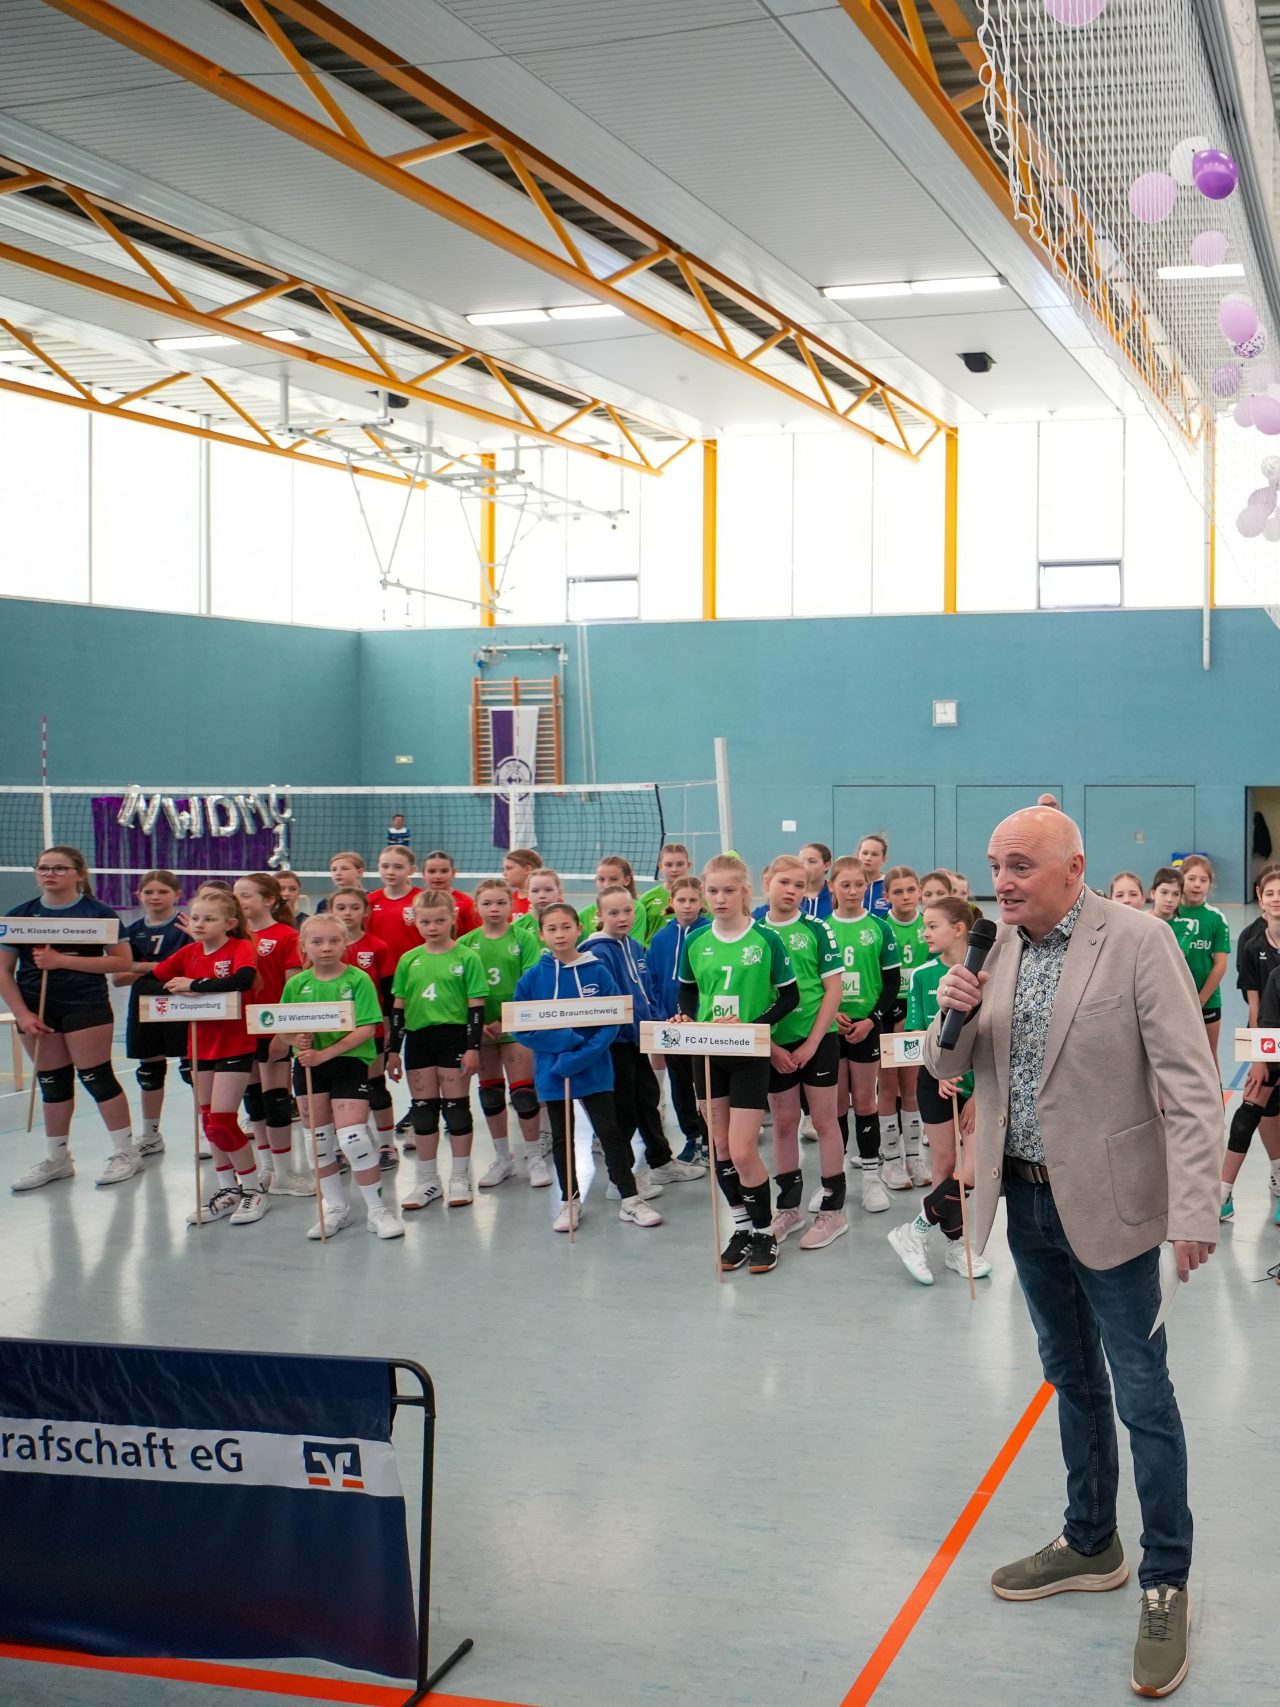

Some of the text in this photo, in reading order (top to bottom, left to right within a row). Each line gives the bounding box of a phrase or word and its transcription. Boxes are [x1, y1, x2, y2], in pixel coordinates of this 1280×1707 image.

[62, 927, 98, 935] Oesede
[151, 935, 165, 955] 7
[844, 946, 855, 966] 6
[903, 945, 913, 964] 5
[487, 967, 501, 985] 3
[721, 966, 733, 990] 7
[422, 982, 437, 1001] 4
[179, 1002, 221, 1011] Cloppenburg
[539, 1011, 558, 1019] USC
[559, 1007, 618, 1017] Braunschweig
[713, 1005, 737, 1017] BvL
[278, 1012, 339, 1022] SV Wietmarschen
[709, 1037, 750, 1046] Leschede
[1, 1424, 244, 1474] rafschaft eG
